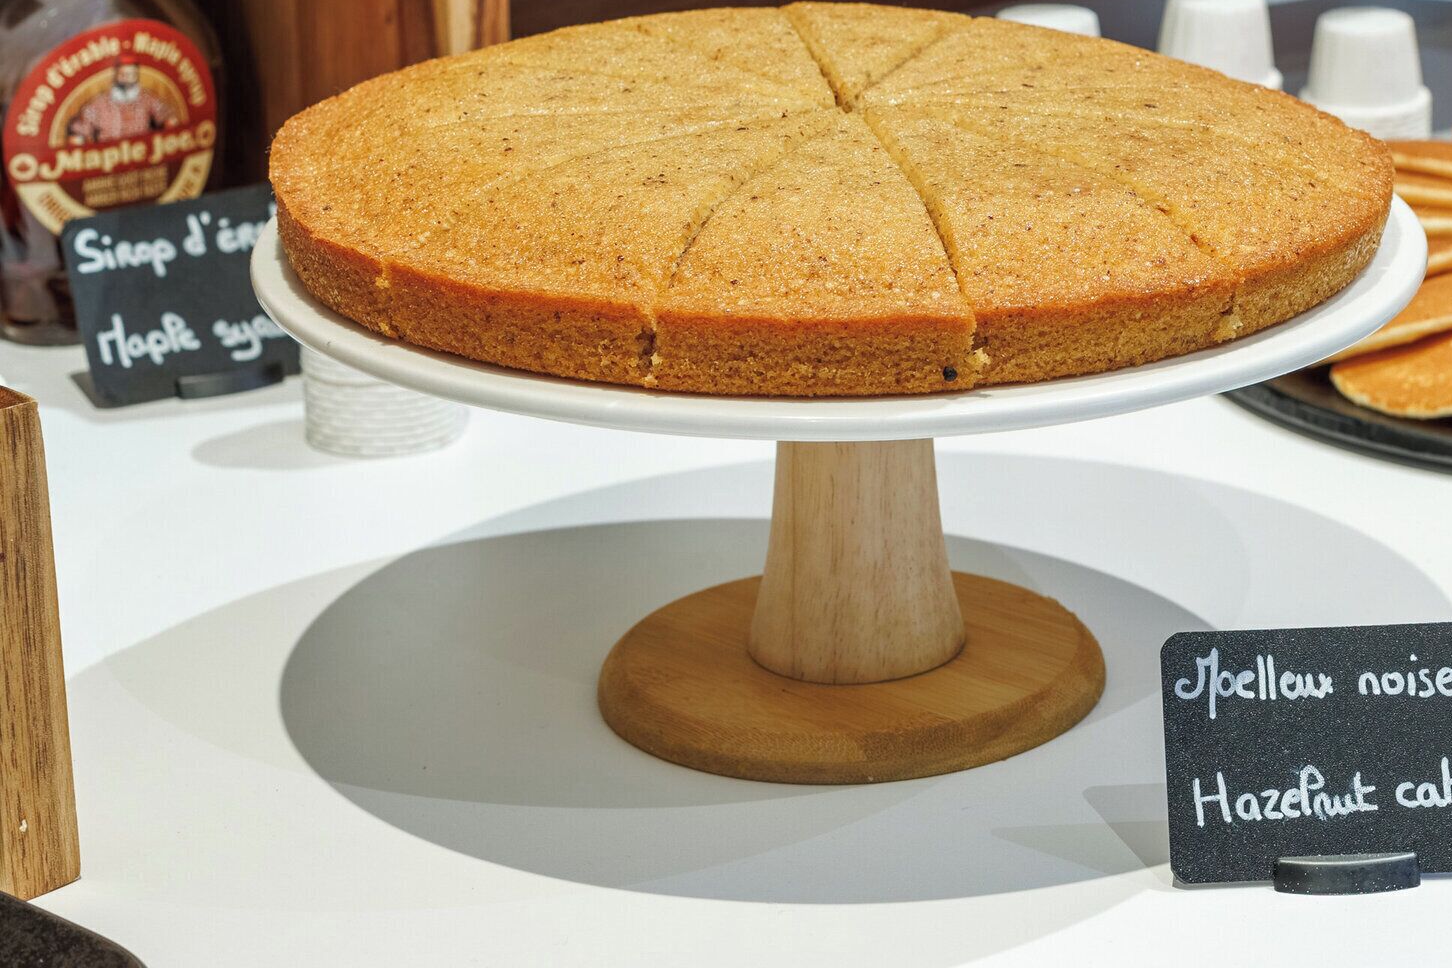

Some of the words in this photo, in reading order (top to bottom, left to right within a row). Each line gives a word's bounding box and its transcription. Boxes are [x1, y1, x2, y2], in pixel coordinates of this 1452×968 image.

[38, 141, 147, 180] Maple
[96, 311, 201, 368] Maple
[1174, 647, 1333, 719] Moelleux
[1192, 764, 1378, 828] Hazelnut
